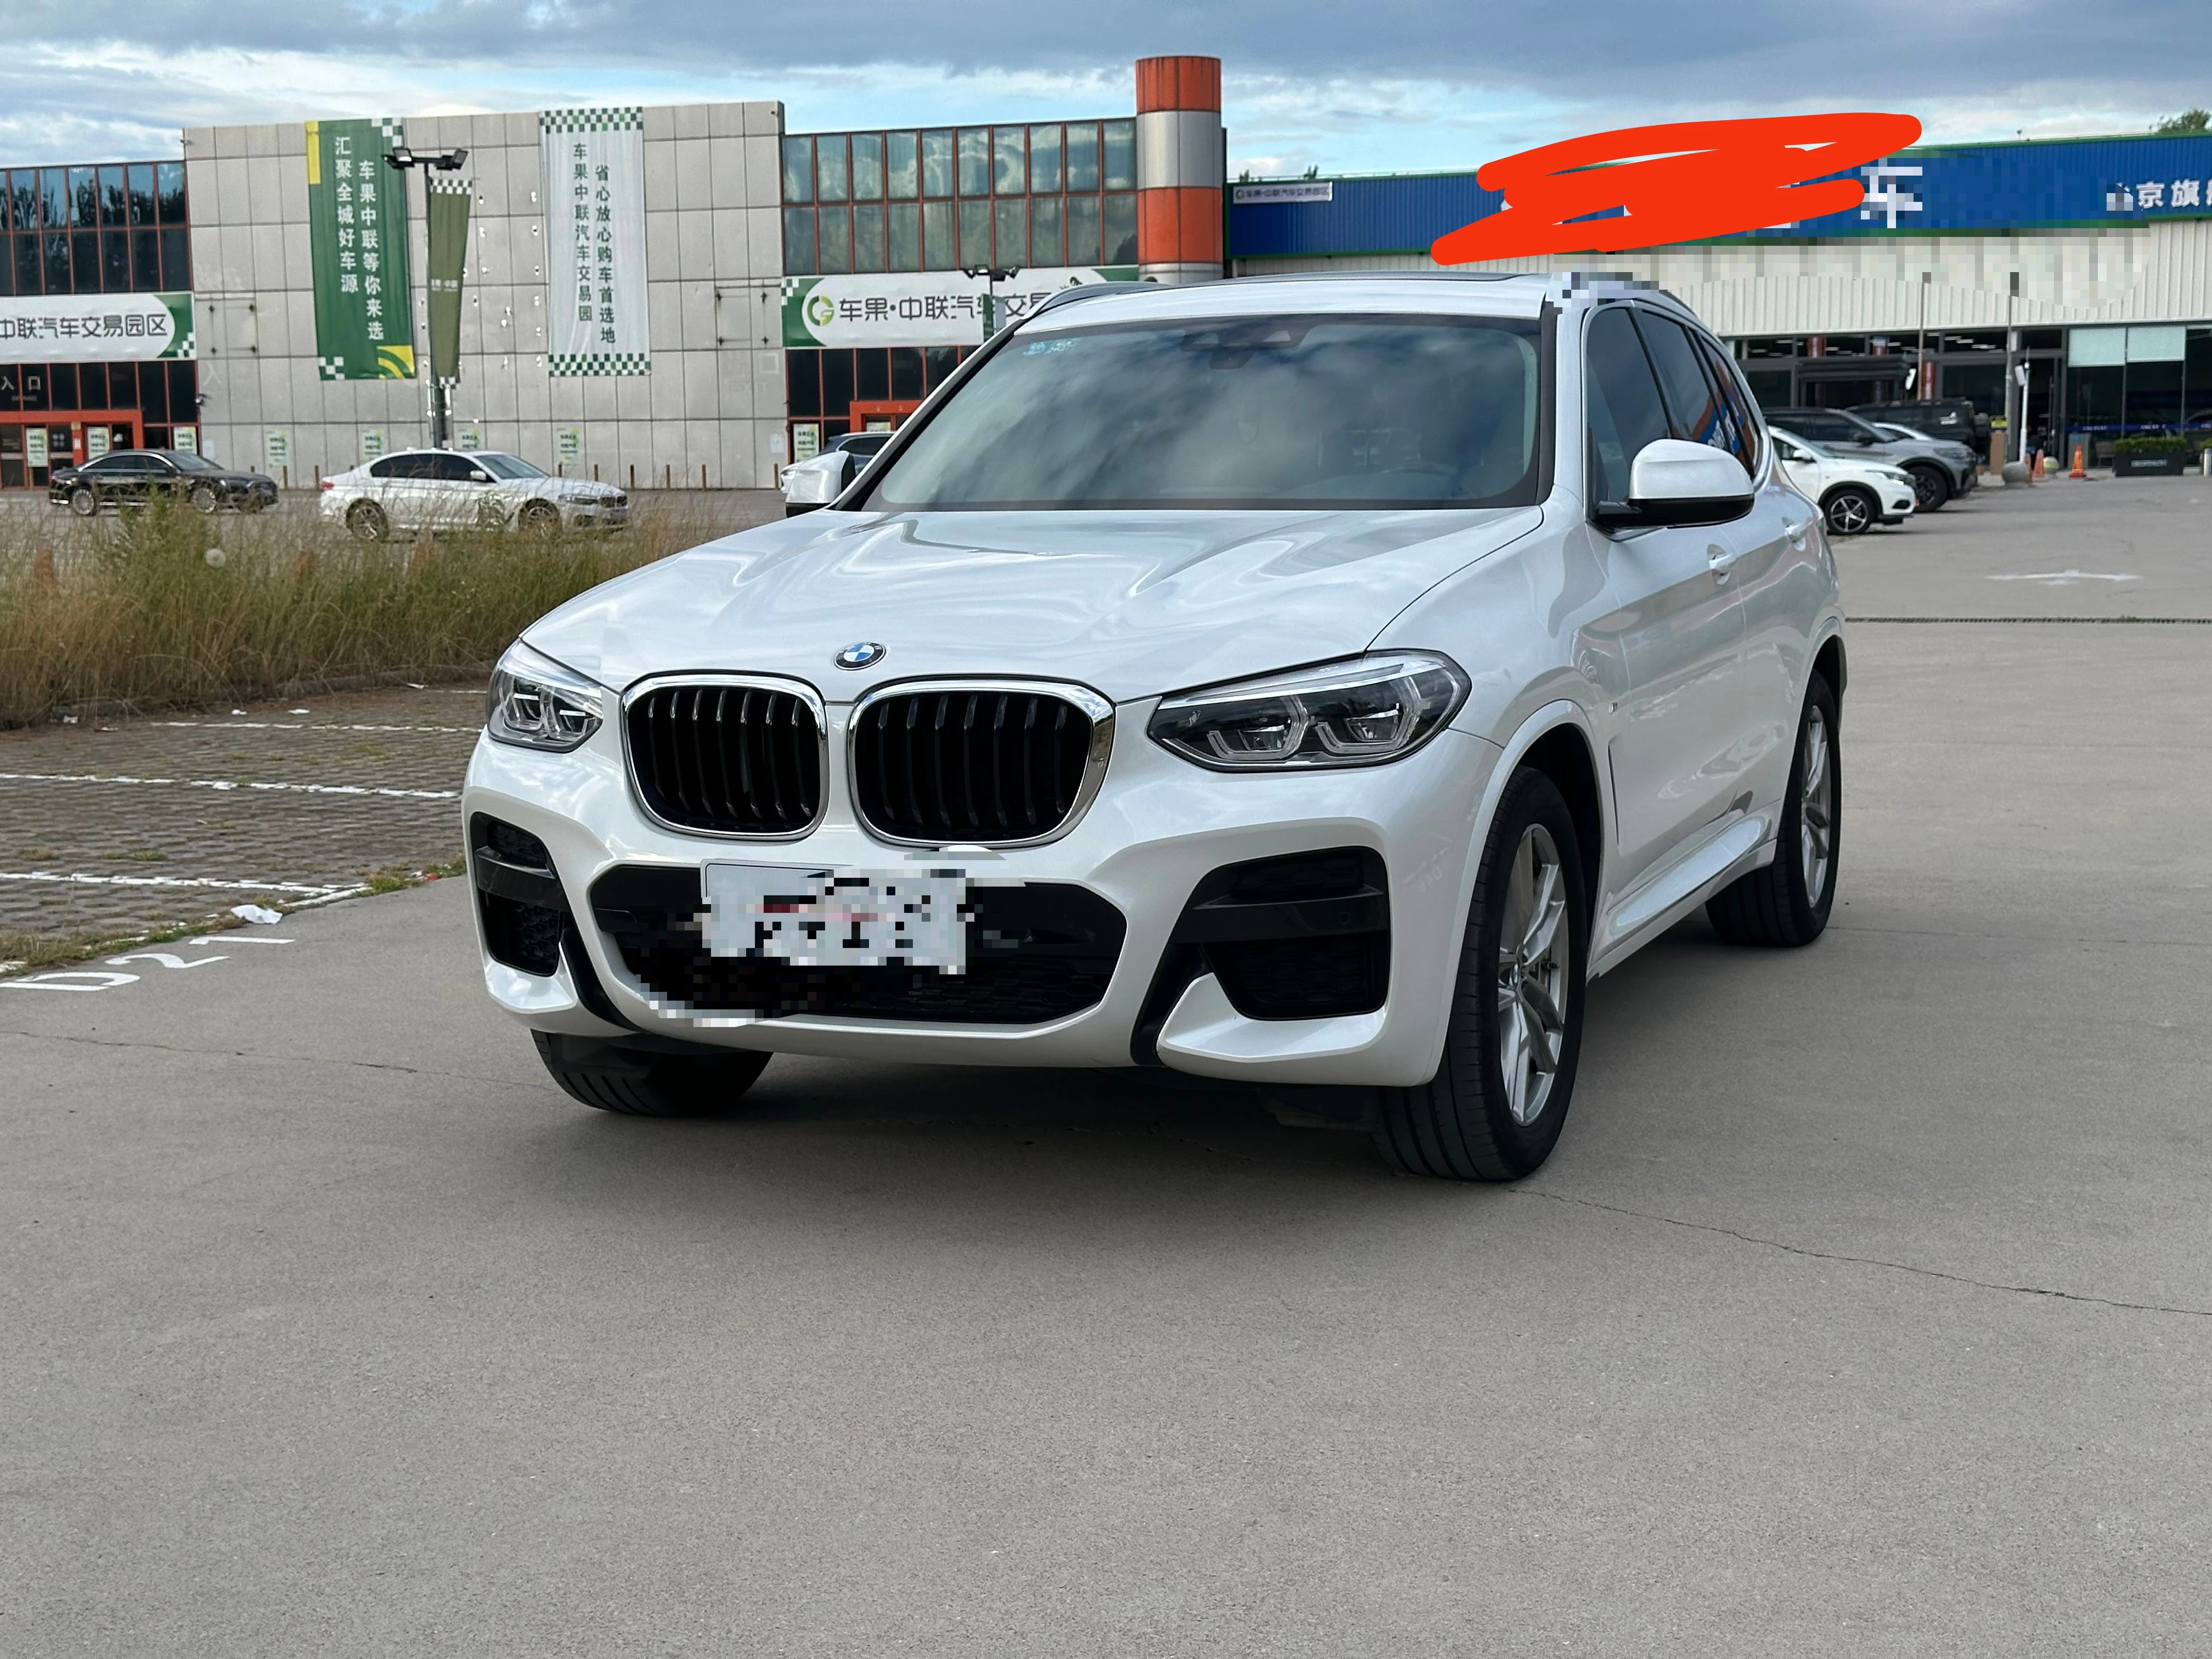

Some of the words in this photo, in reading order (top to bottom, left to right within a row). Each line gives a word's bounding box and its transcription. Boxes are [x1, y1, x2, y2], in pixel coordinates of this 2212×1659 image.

[335, 136, 358, 293] 汇聚全城好车源
[358, 160, 384, 340] 车果中联等你来选
[573, 143, 592, 321] 车果中联汽车交易园
[595, 165, 616, 344] 省心放心购车首选地
[1, 376, 41, 391] 入口
